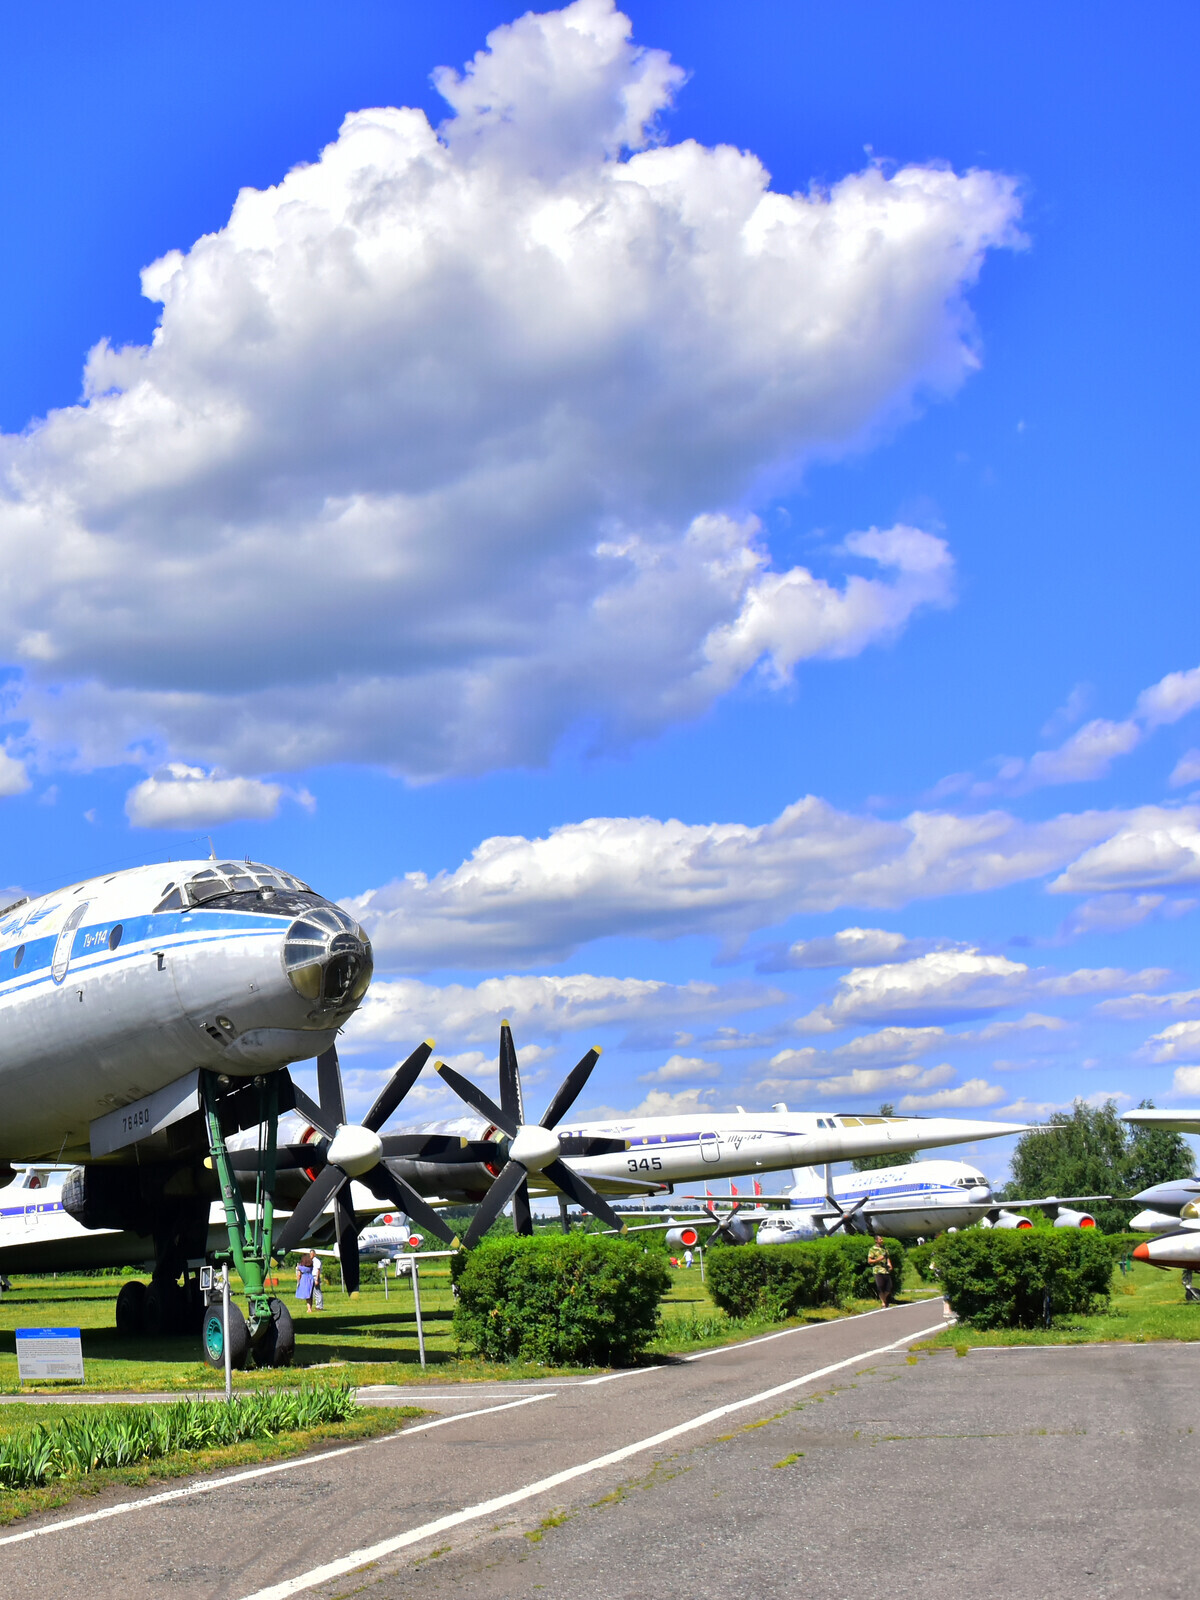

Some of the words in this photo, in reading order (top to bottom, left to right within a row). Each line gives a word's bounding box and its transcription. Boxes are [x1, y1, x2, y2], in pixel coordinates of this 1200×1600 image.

[83, 929, 108, 948] Ту-114
[122, 1108, 149, 1132] 76490
[627, 1157, 663, 1173] 345
